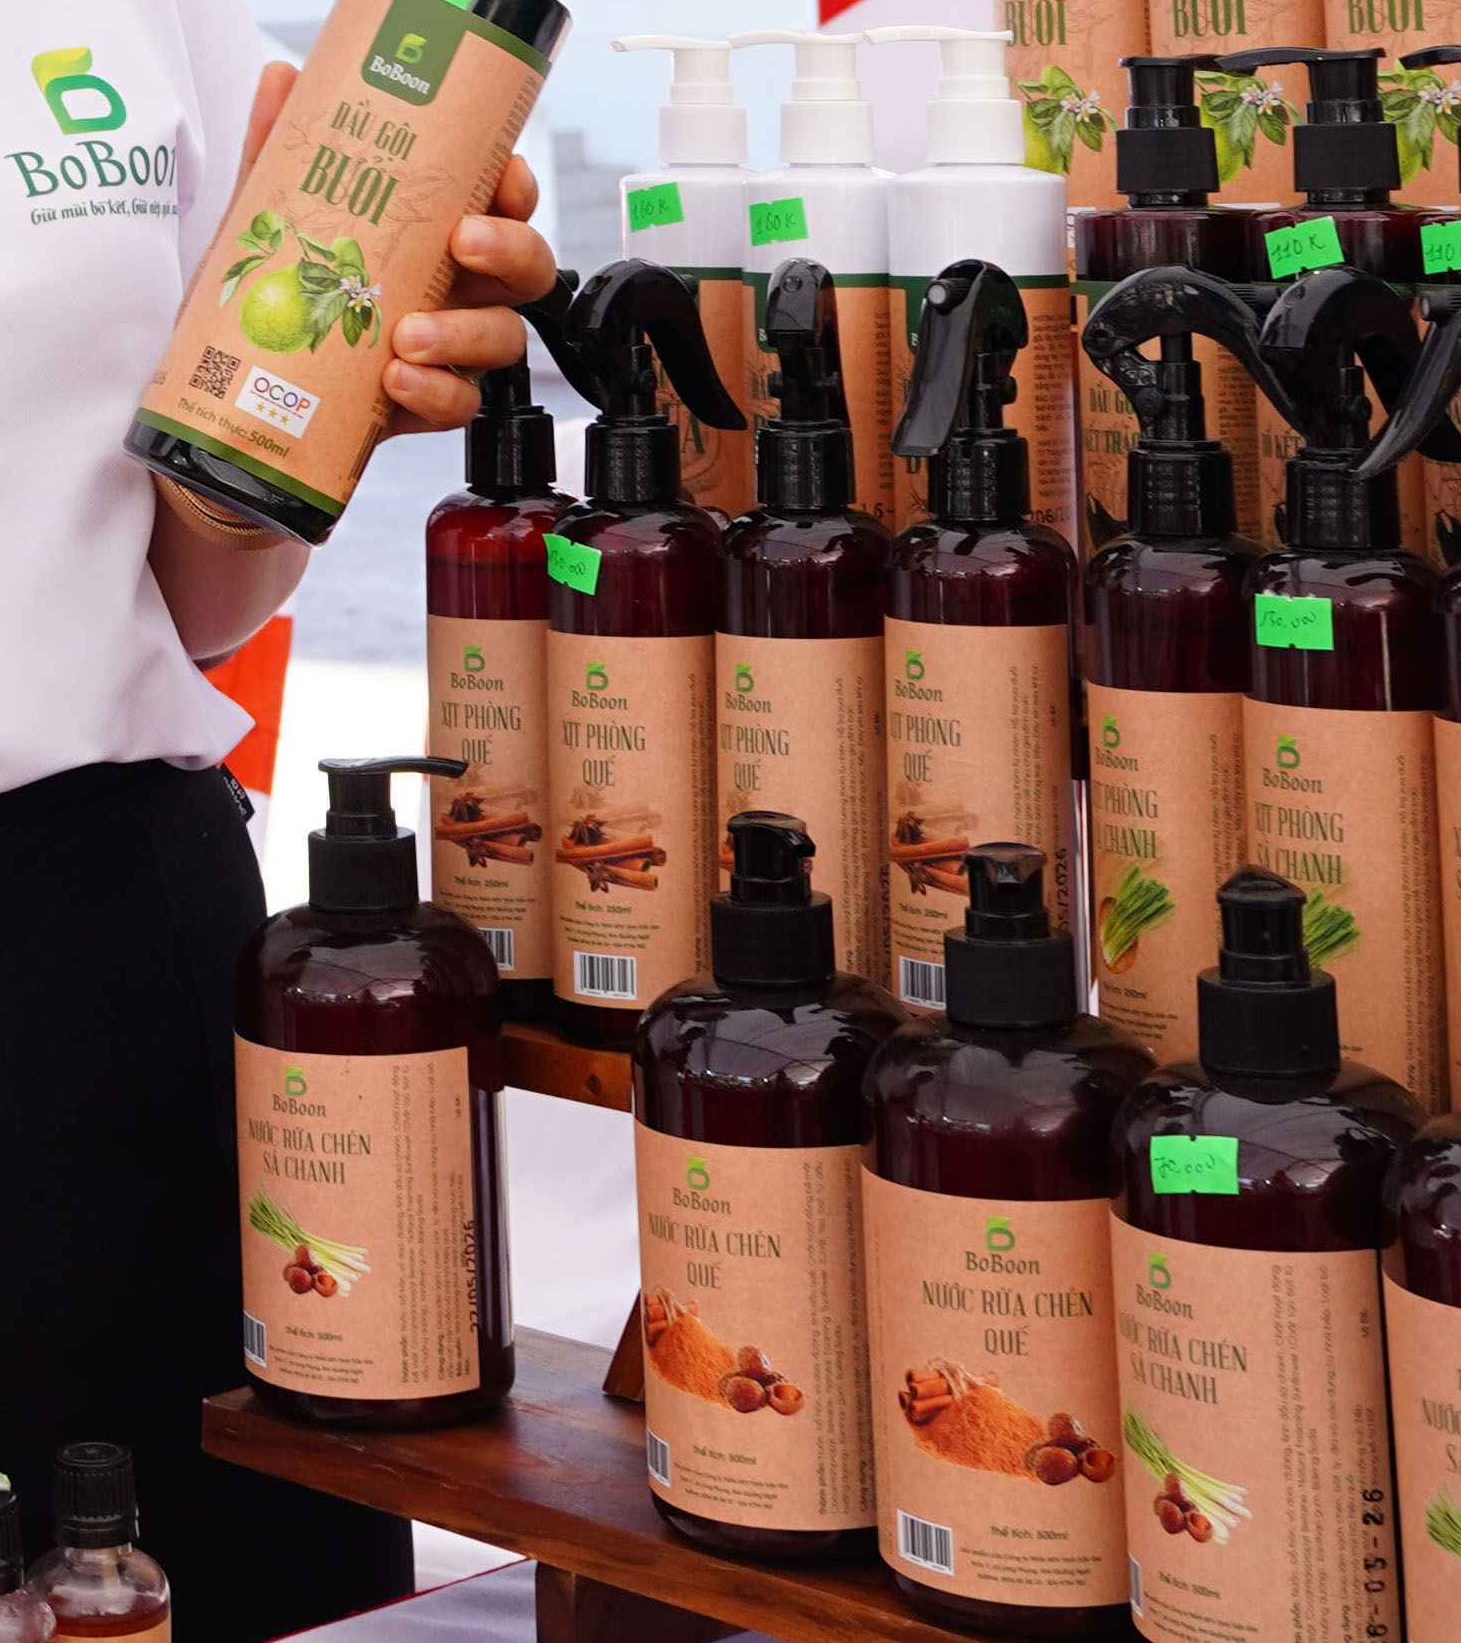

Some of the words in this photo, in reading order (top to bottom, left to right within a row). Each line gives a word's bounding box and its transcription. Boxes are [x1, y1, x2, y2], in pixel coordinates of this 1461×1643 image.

[369, 55, 431, 95] BoBoon
[329, 99, 377, 141] DẦU
[374, 122, 418, 161] GỘI
[300, 144, 400, 226] BƯỞI
[254, 377, 311, 413] OCOP
[248, 430, 291, 458] 500ml
[450, 672, 504, 691] BoBoon
[894, 680, 943, 703] BoBoon
[571, 690, 627, 710] BoBoon
[725, 692, 772, 713] BoBoon
[465, 701, 521, 731] PHÒNG
[906, 712, 961, 747] PHÒNG
[462, 734, 493, 765] QUẾ
[586, 720, 646, 751] PHÒNG
[736, 723, 790, 756] PHÒNG
[582, 755, 615, 787] QUẾ
[734, 759, 761, 791] QUẾ
[904, 749, 933, 783] QUẾ
[1262, 768, 1323, 794] BoBoon
[1277, 803, 1344, 843] PHÒNG
[1274, 847, 1342, 885] CHANH
[272, 1094, 326, 1117] BoBoon
[283, 1127, 315, 1153] RỬA
[322, 1131, 371, 1155] CHÉN
[285, 1156, 345, 1184] CHANH
[673, 1187, 731, 1214] BoBoon
[684, 1223, 719, 1253] RỬA
[726, 1230, 781, 1258] CHÉN
[687, 1260, 721, 1289] QUẾ
[965, 1251, 1041, 1274] BoBoon
[922, 1280, 974, 1313] NƯỚC
[982, 1287, 1028, 1317] RỬA
[1034, 1287, 1094, 1317] CHÉN
[1135, 1284, 1194, 1320] BoBoon
[984, 1326, 1029, 1356] QUẾ
[1147, 1322, 1182, 1361] RỬA
[1188, 1338, 1248, 1372] CHÉN
[1150, 1362, 1218, 1405] CHANH
